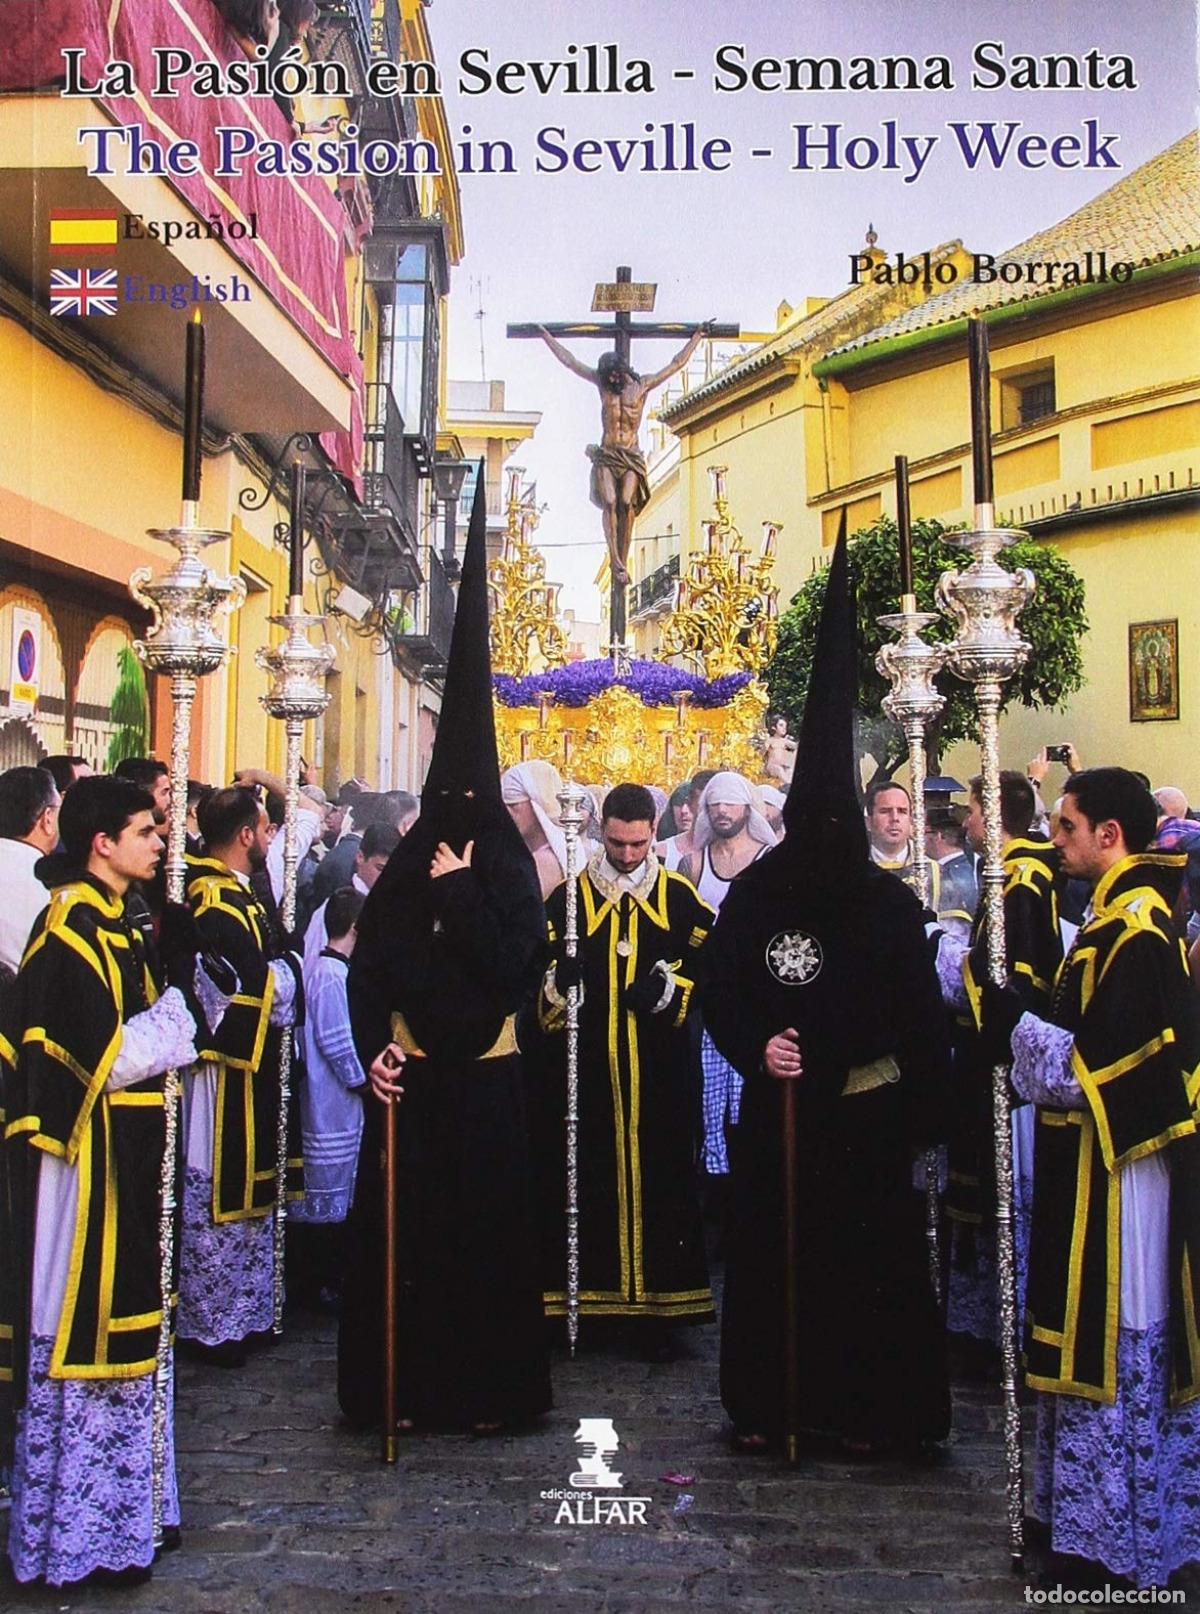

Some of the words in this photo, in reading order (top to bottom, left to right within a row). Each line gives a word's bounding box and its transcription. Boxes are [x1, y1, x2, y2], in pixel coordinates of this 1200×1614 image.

[62, 49, 135, 96] La
[154, 44, 350, 96] Pasión
[369, 61, 440, 95] en
[459, 43, 653, 94] Sevilla
[715, 45, 955, 92] Semana
[973, 43, 1137, 90] Santa
[79, 125, 198, 175] The
[216, 125, 441, 175] Passion
[459, 125, 514, 174] in
[536, 123, 732, 172] Seville
[792, 120, 937, 183] Holy
[948, 119, 1121, 169] Week
[123, 214, 259, 245] Español
[848, 253, 958, 286] Pablo
[971, 252, 1134, 285] Borrallo
[124, 275, 251, 309] English
[540, 1488, 593, 1500] ediciones
[554, 1497, 652, 1525] ALFAR
